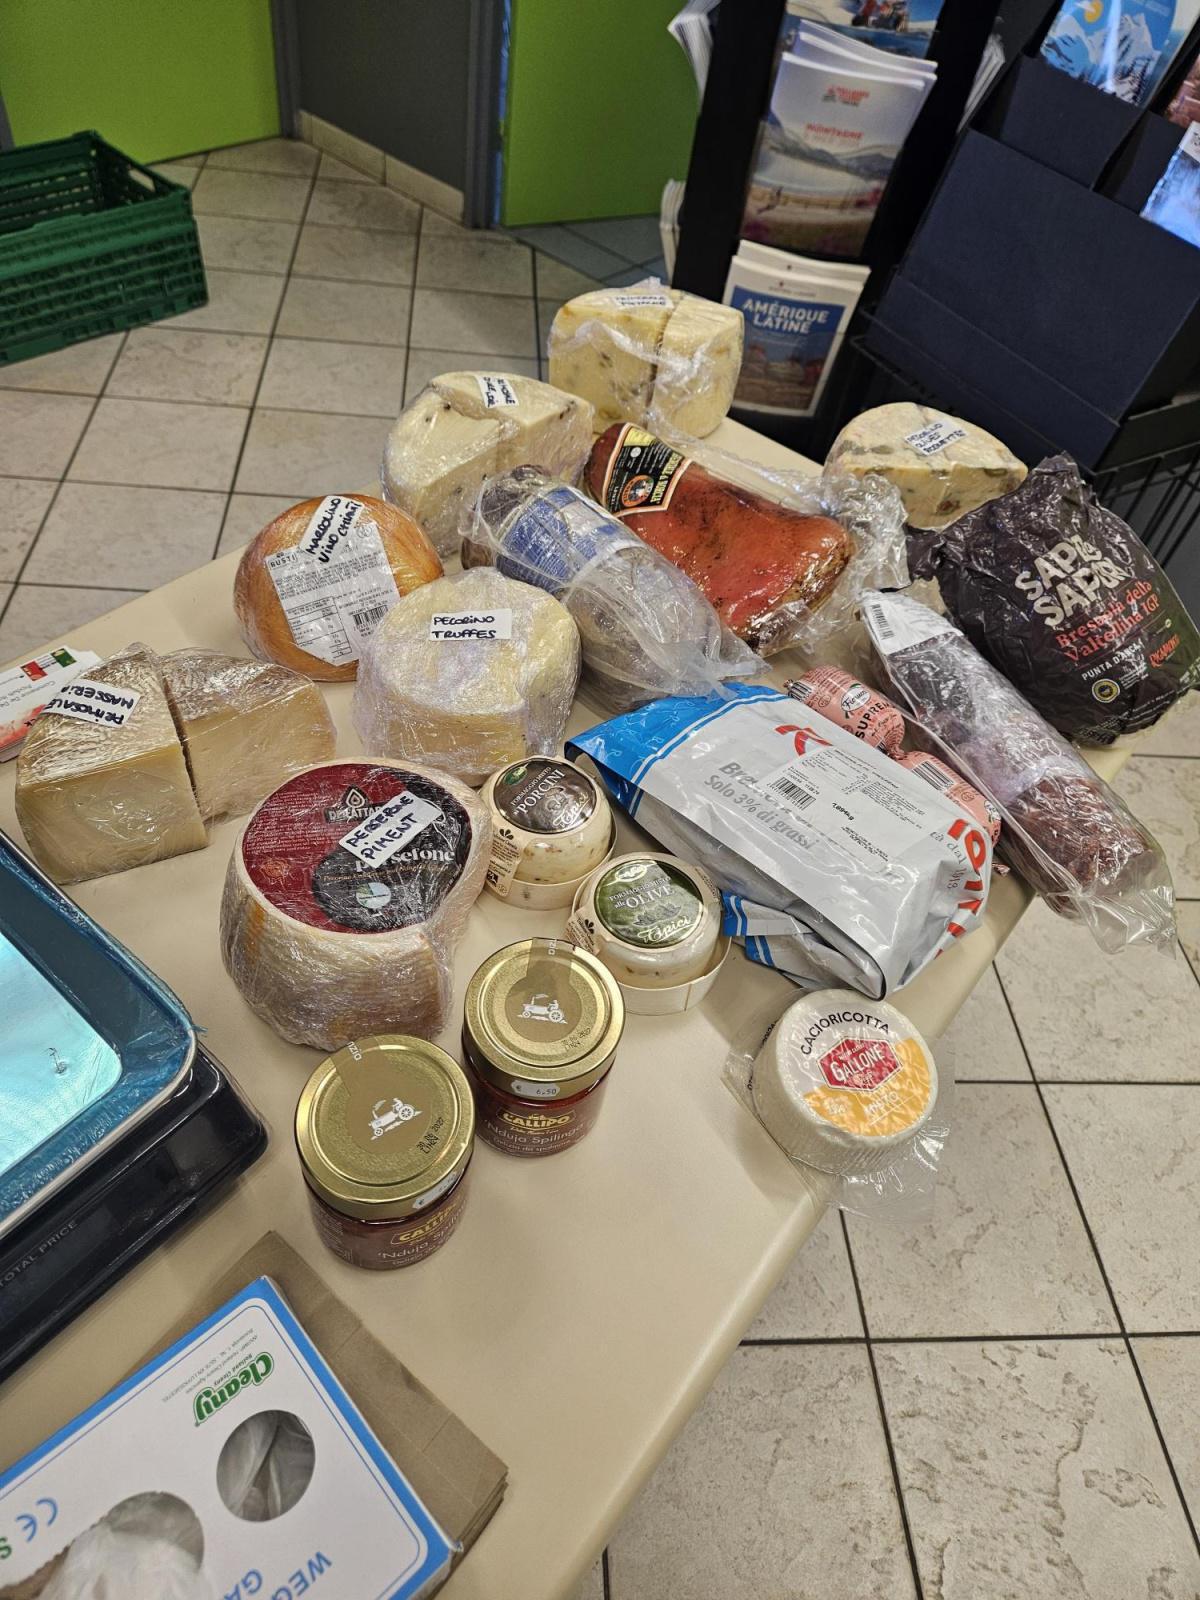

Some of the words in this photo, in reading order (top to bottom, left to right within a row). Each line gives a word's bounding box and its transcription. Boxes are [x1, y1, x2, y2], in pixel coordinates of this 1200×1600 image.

[743, 298, 829, 323] AMÉRIQUE
[753, 313, 812, 334] LATINE
[1126, 580, 1153, 605] della
[1064, 609, 1143, 663] Valtellina
[1142, 594, 1161, 616] IGP
[1081, 661, 1112, 681] PUNTA
[517, 768, 566, 814] PORCINI
[704, 775, 735, 797] Solo
[734, 793, 760, 813] 3%
[756, 810, 779, 823] di
[769, 820, 820, 850] grassi
[360, 812, 418, 860] PIMENT
[625, 884, 675, 909] OLIVE
[800, 1011, 890, 1055] CACIORICOTTA
[503, 1112, 570, 1128] CALLIPO
[39, 1221, 78, 1253] PRICE
[193, 1352, 275, 1425] Cleany
